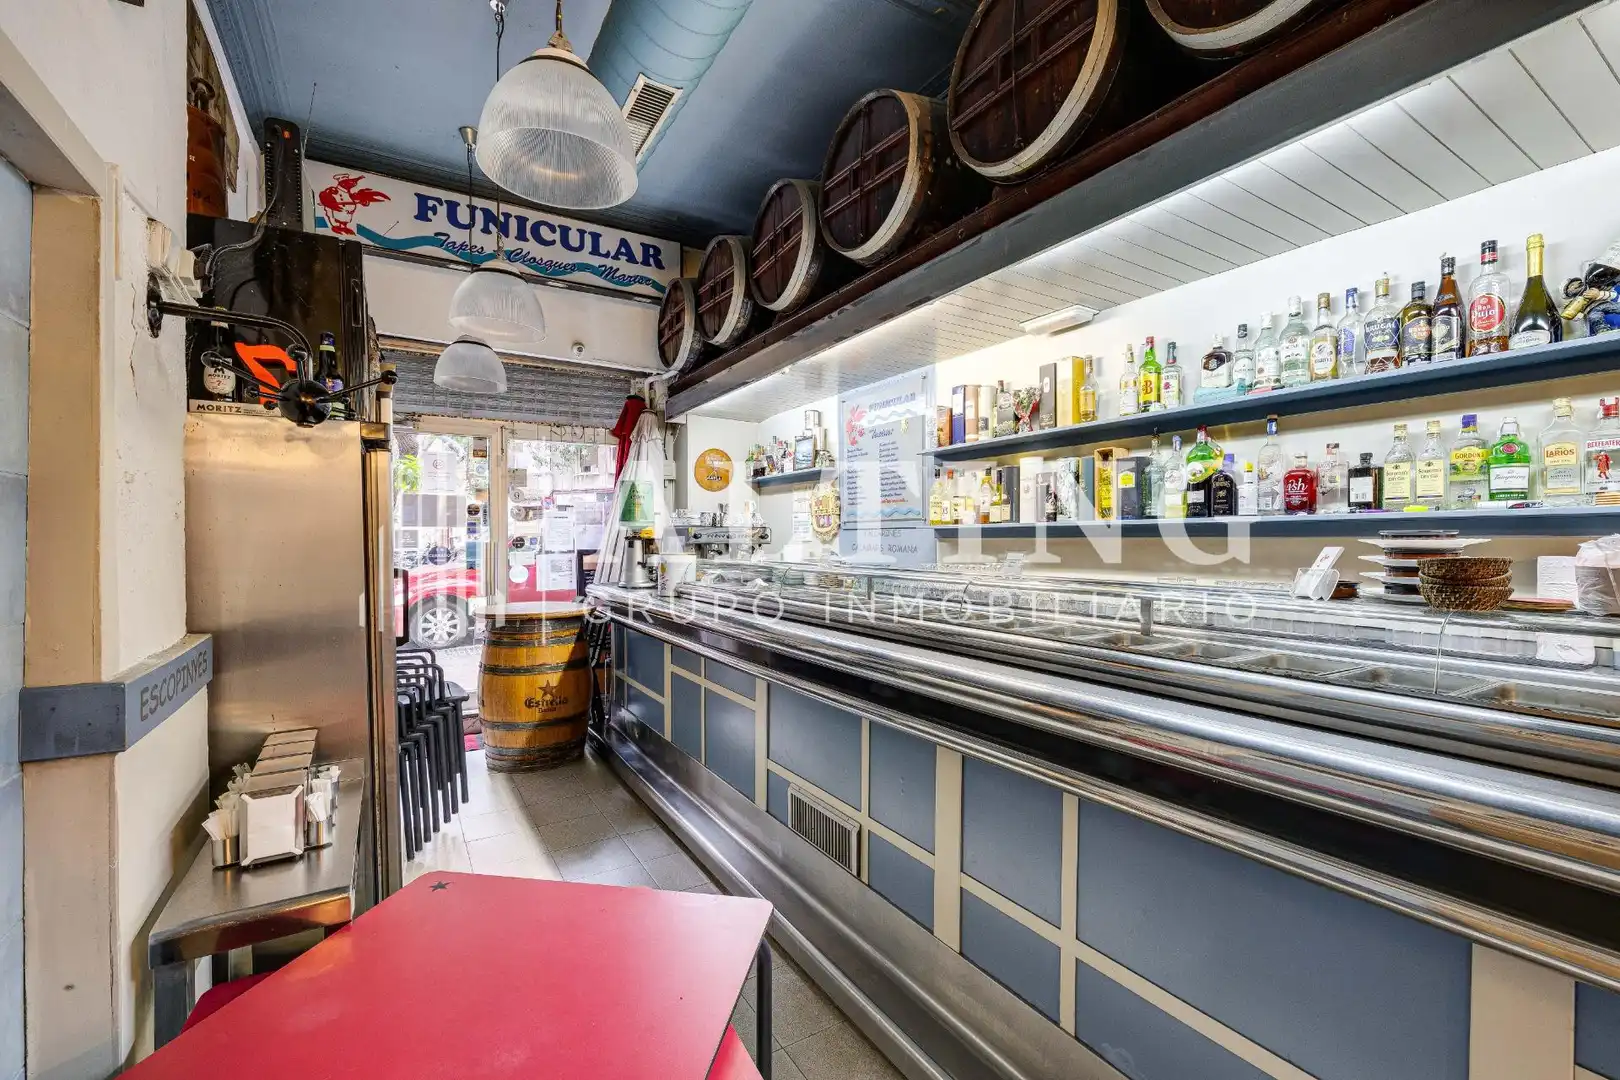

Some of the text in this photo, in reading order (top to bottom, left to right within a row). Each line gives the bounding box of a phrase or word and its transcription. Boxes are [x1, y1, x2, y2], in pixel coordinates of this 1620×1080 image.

[413, 192, 666, 270] FUNICULAR
[433, 231, 485, 256] Tapes
[507, 247, 578, 272] Closques
[196, 403, 242, 413] MORITZ
[1546, 448, 1575, 459] LARIOS
[140, 649, 209, 722] ESCOPINYES
